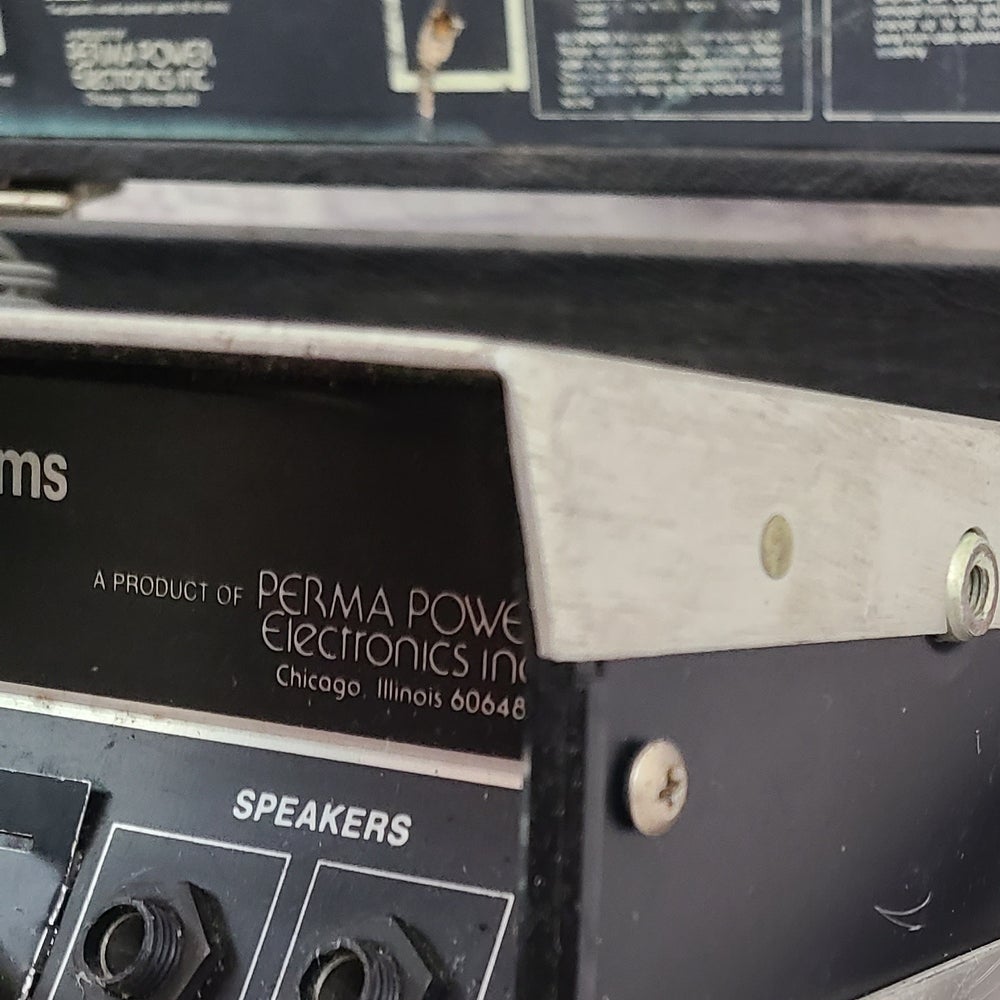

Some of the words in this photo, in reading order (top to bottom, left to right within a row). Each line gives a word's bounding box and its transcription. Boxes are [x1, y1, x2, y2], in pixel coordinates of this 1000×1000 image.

[93, 569, 106, 591] A
[113, 572, 209, 603] PRODUCT
[216, 584, 245, 606] OF
[258, 568, 394, 627] PERMA
[408, 588, 525, 645] POWE
[261, 609, 470, 679] Electronics
[276, 662, 361, 700] Chicago
[376, 676, 443, 709] Illinois
[450, 687, 526, 721] 60648
[232, 787, 413, 848] SPEAKERS
